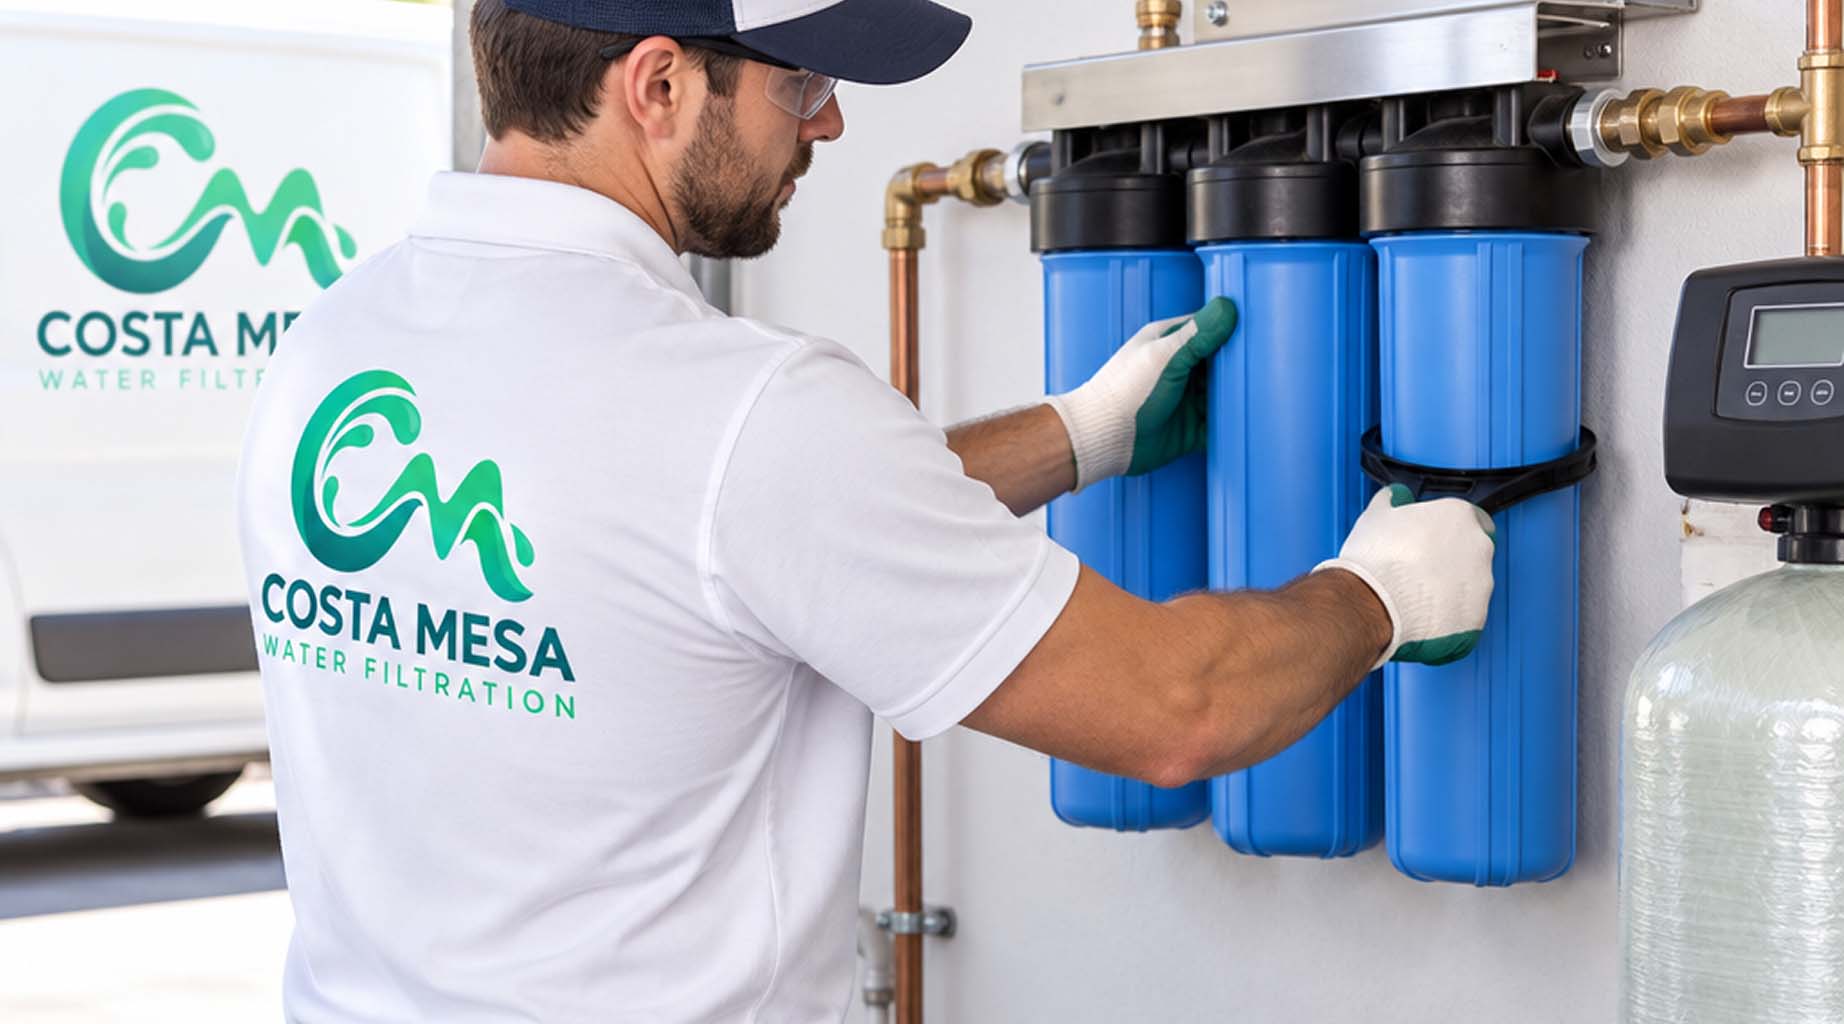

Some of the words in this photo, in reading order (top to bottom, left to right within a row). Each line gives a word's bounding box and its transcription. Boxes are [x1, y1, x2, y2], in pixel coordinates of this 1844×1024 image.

[37, 310, 218, 357] COSTA
[38, 368, 156, 390] WATER
[262, 573, 401, 651] COSTA
[416, 603, 576, 683] MESA
[263, 634, 347, 674] WATER
[364, 657, 577, 720] FILTRATION
